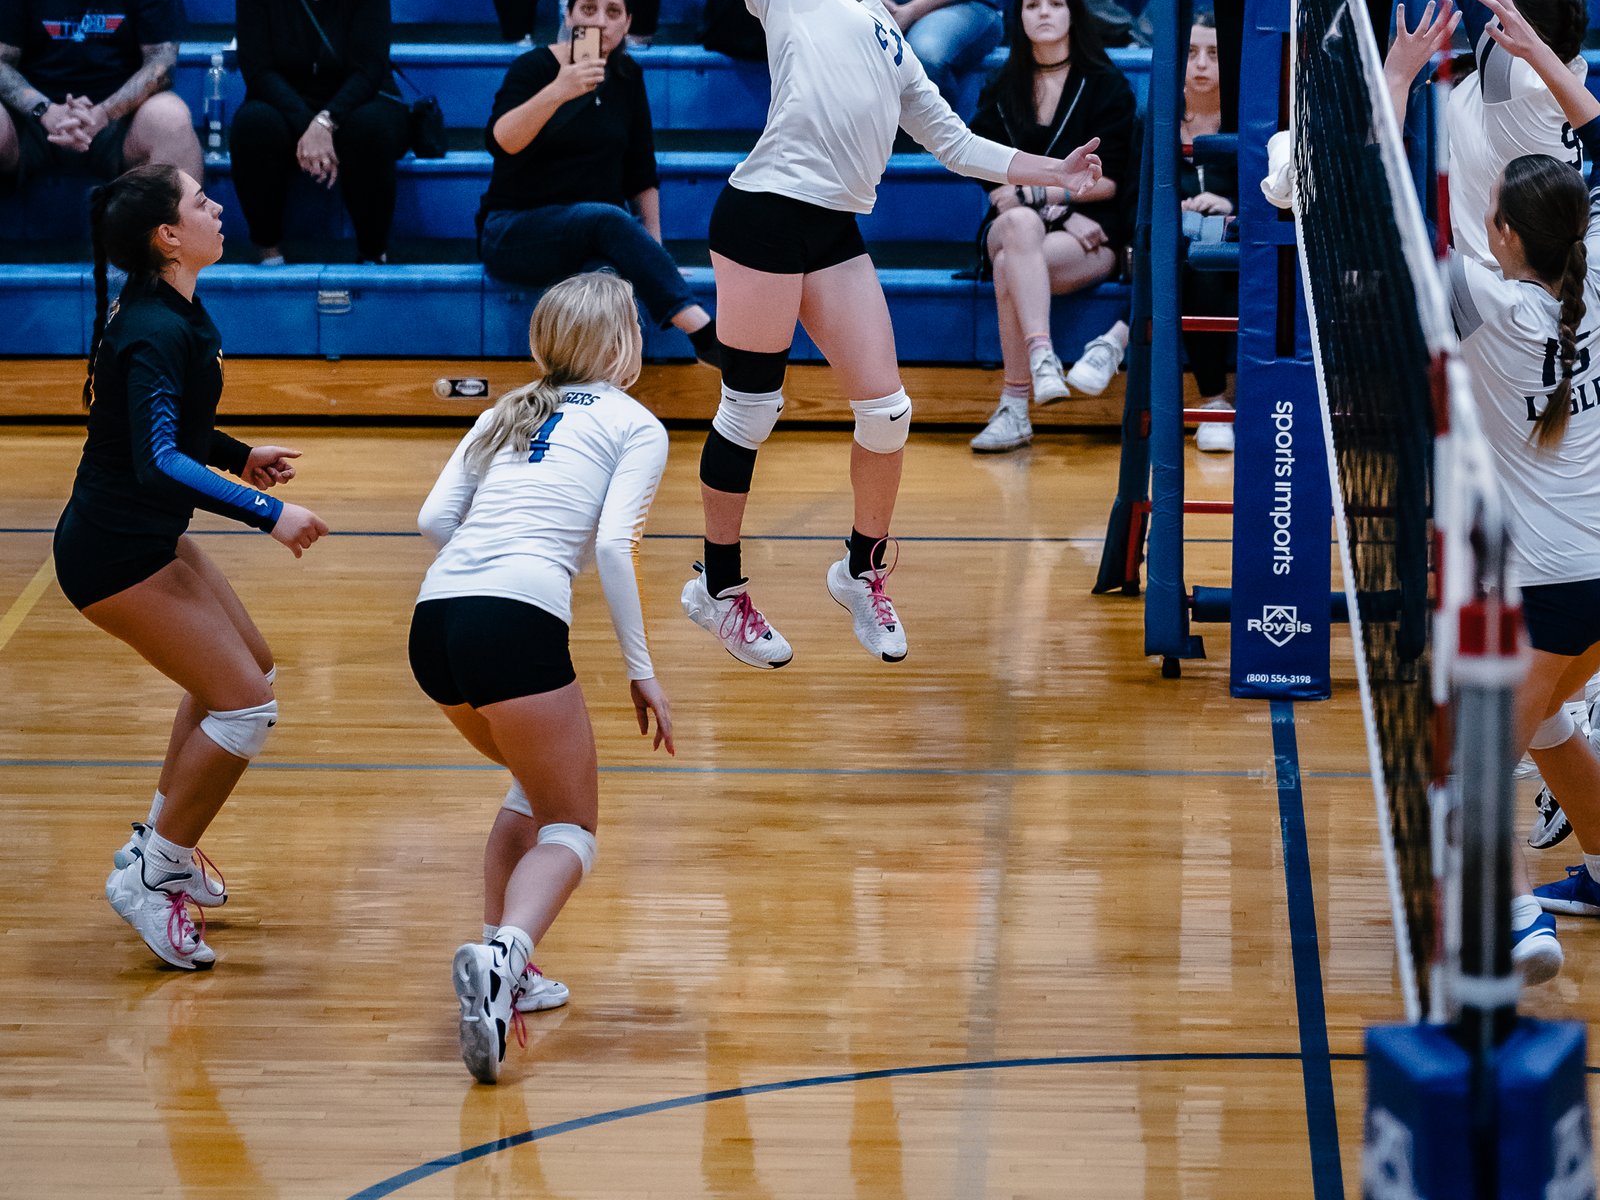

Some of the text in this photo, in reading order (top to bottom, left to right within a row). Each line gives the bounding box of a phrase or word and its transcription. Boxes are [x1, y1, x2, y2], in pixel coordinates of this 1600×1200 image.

[528, 412, 564, 463] 4
[1269, 400, 1295, 575] sports imports
[1247, 618, 1312, 635] Royals
[1246, 673, 1312, 685] (800) 556-3198
